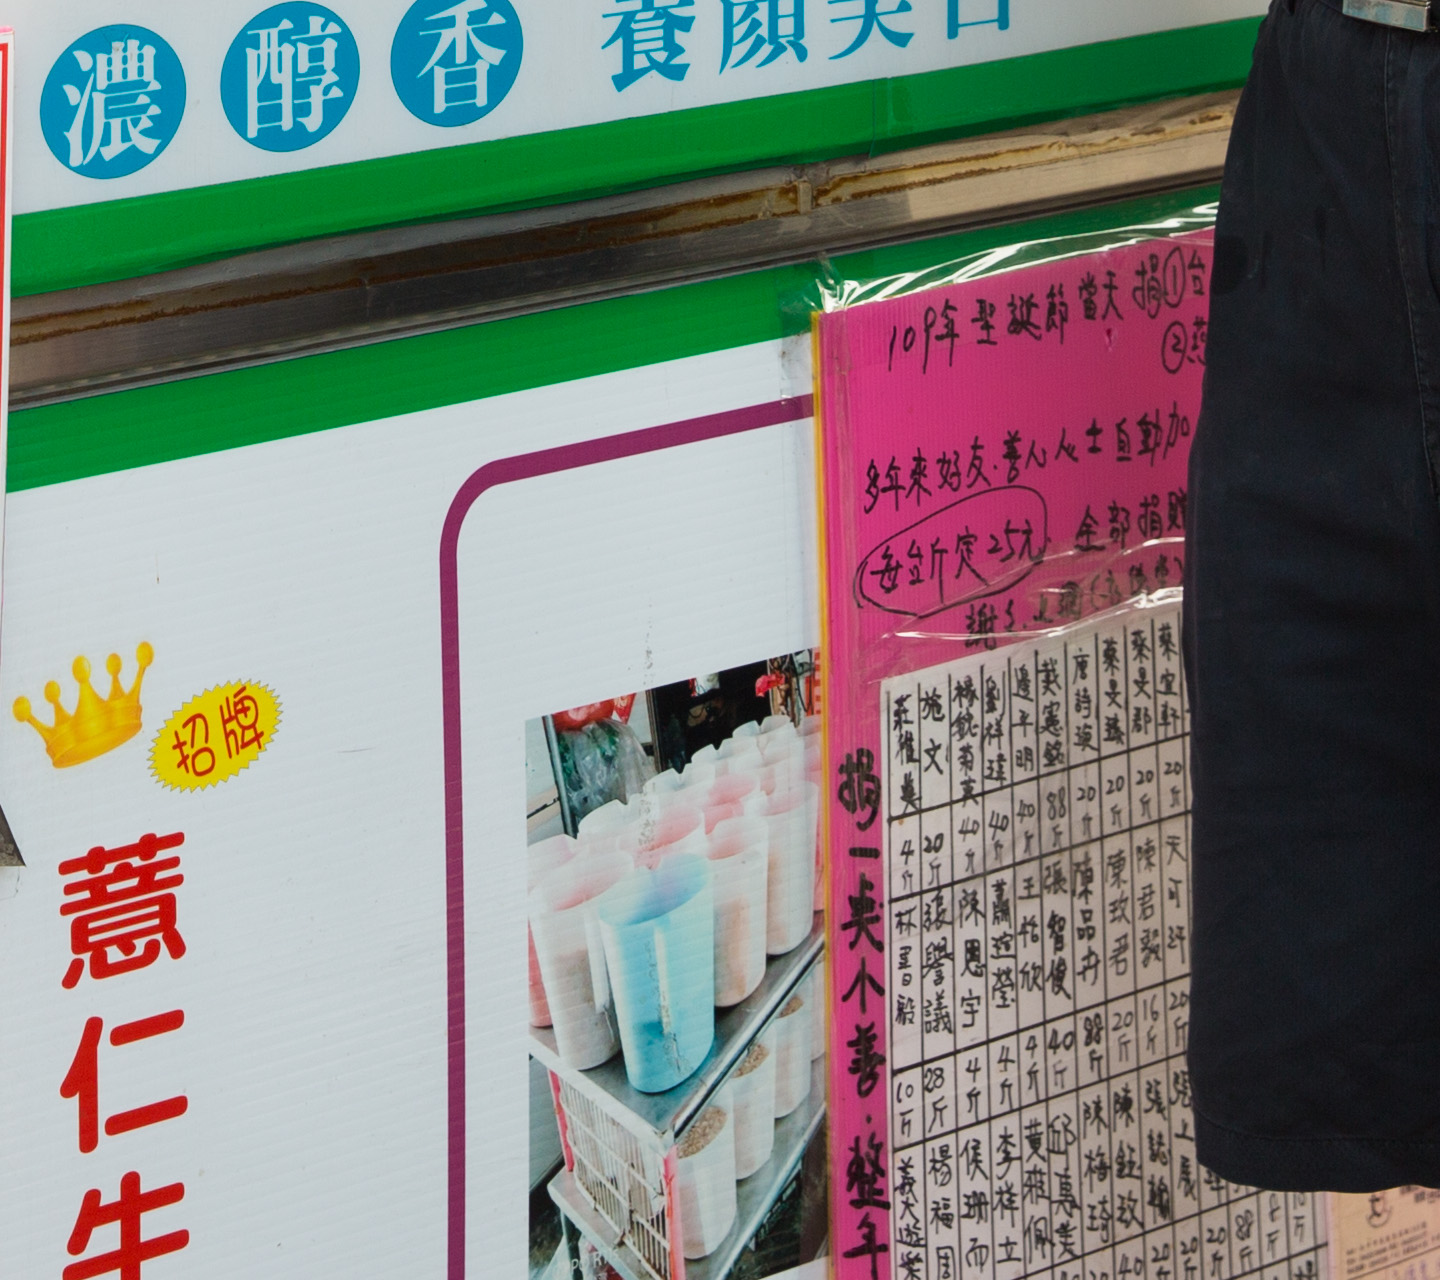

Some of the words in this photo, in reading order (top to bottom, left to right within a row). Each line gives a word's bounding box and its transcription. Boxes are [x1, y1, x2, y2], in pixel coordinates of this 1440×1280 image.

[60, 6, 508, 173] 濃醇香
[171, 684, 264, 778] 招牌
